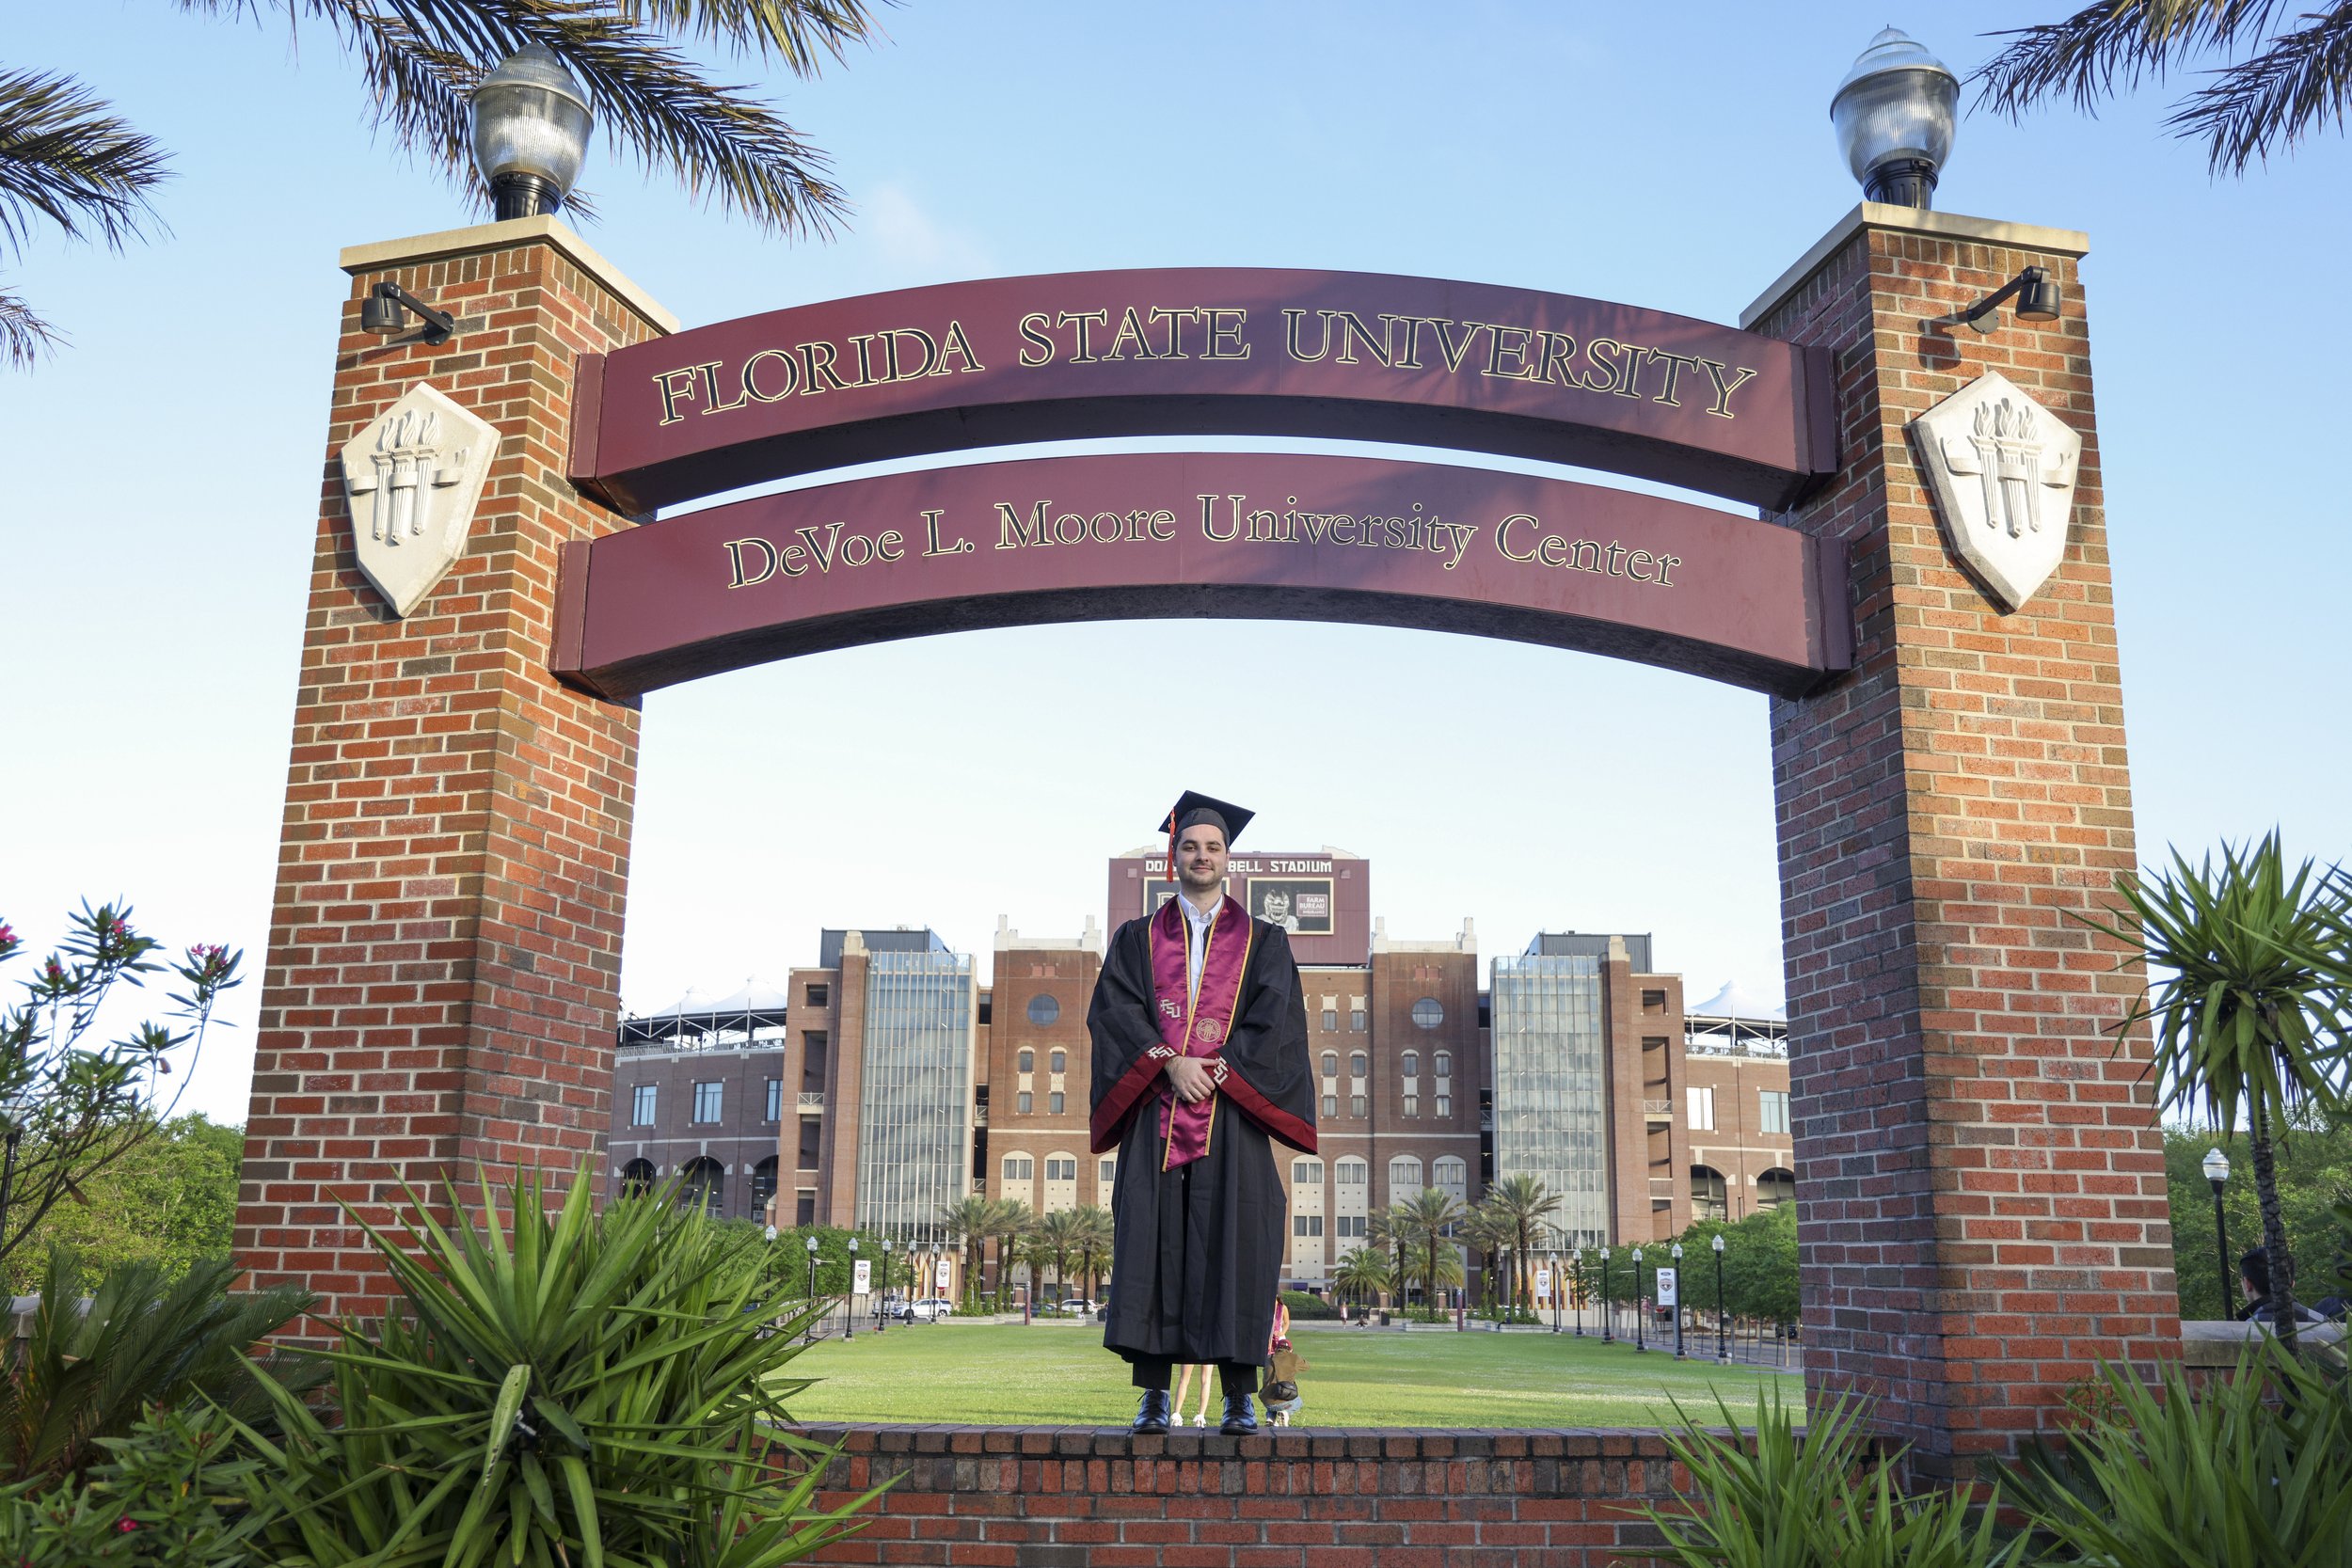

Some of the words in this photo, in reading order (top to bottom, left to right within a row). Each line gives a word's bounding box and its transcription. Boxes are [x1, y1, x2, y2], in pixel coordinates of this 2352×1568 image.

[653, 321, 985, 425] FLORIDA
[1019, 306, 1250, 368] STATE
[1281, 308, 1757, 420] UNIVERSITY
[723, 522, 904, 590] DeVoe
[920, 509, 976, 558] L.
[993, 499, 1177, 549] Moore
[1197, 495, 1479, 570] University
[1495, 514, 1682, 588] Center
[1228, 860, 1263, 873] BELL
[1270, 860, 1332, 873] STADIUM
[1160, 999, 1181, 1019] FSU
